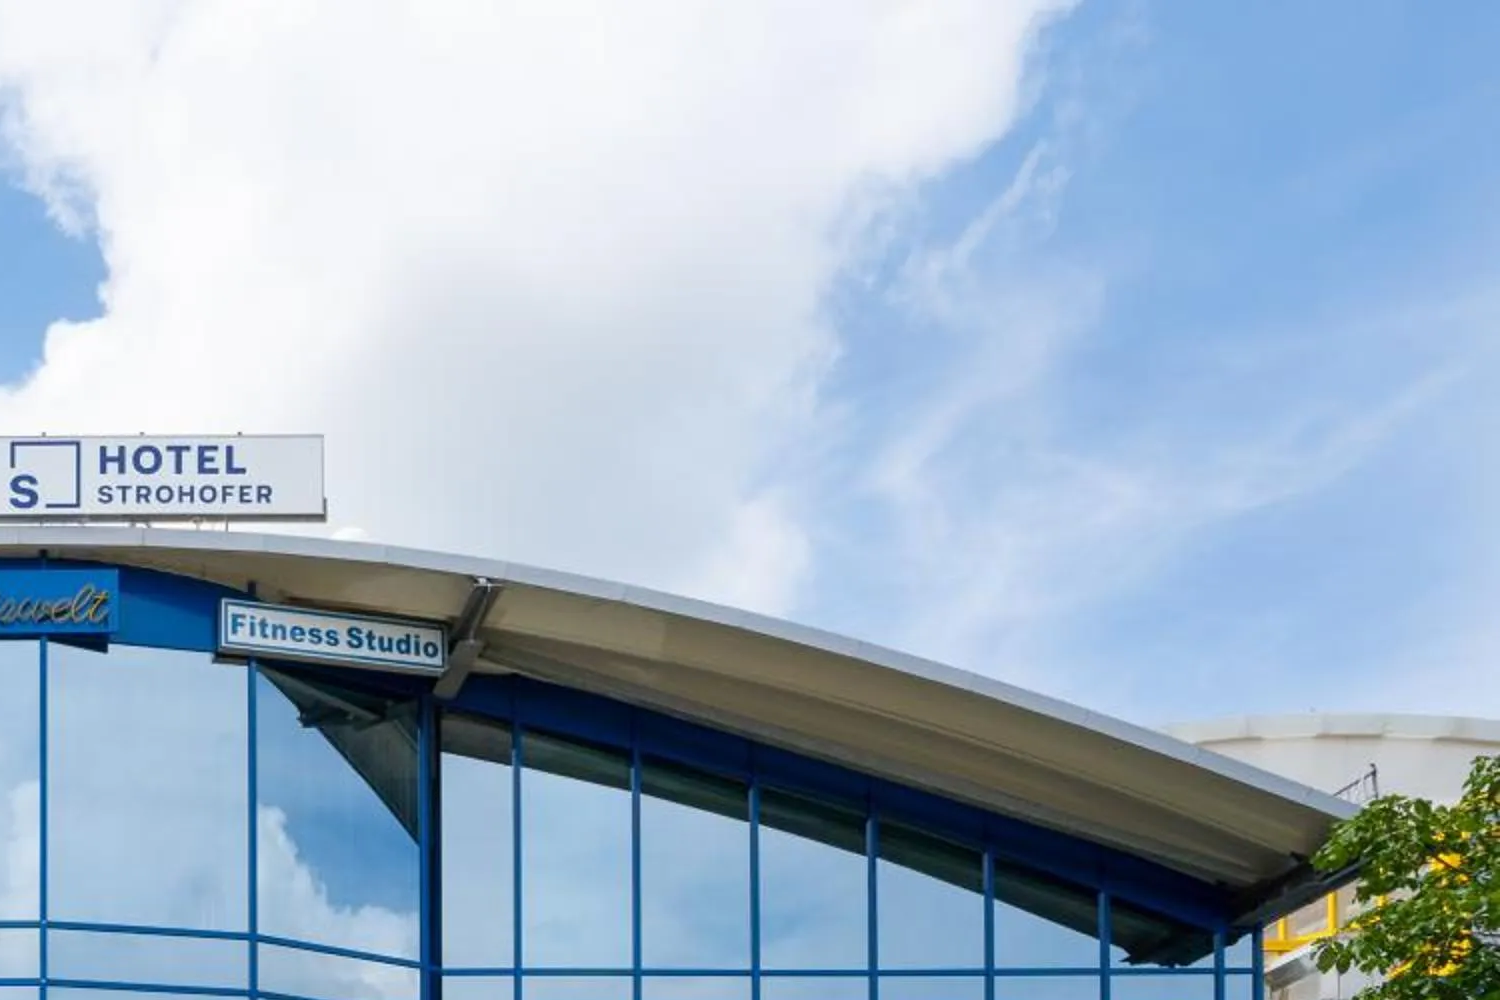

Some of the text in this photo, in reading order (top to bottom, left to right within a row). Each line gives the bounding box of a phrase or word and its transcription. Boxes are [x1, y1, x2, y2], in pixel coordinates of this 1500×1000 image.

[99, 445, 246, 475] HOTEL
[9, 474, 39, 509] S
[97, 484, 273, 504] STROHOFER
[231, 612, 439, 659] Fitness Studio
